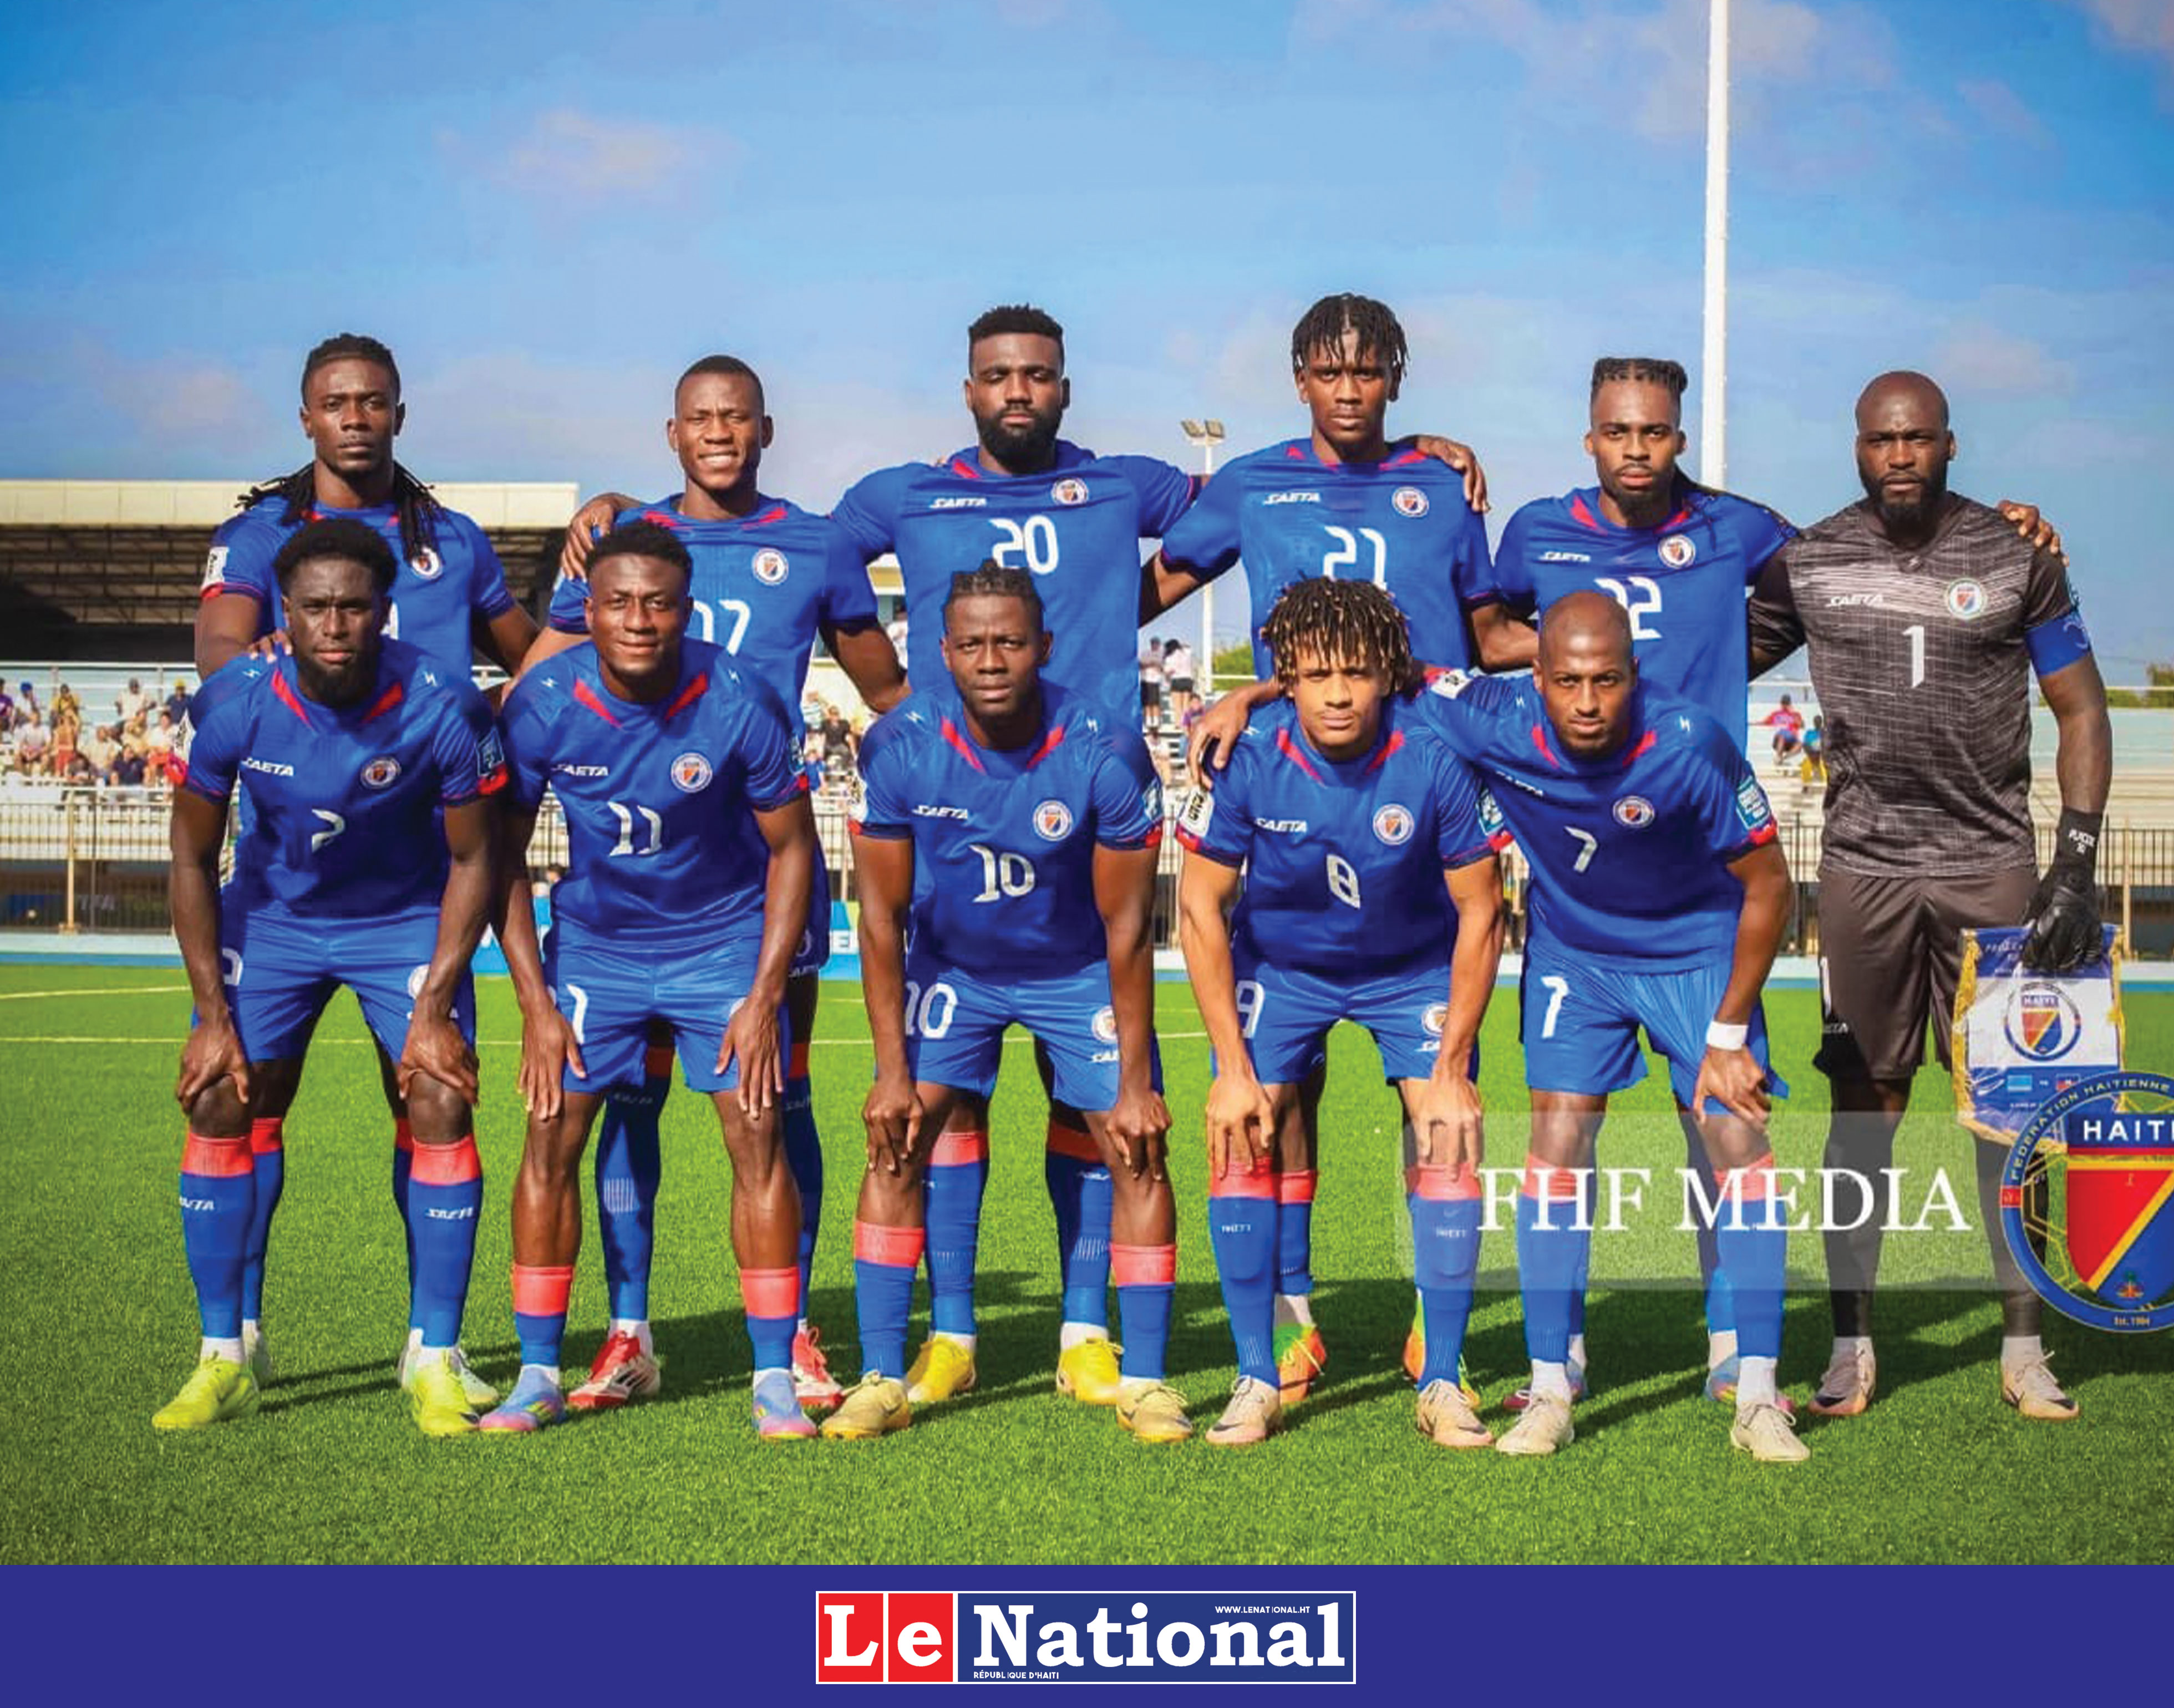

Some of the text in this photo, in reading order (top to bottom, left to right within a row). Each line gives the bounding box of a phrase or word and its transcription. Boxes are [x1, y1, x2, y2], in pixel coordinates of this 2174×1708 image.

[988, 515, 1059, 575] 20
[1903, 625, 1925, 689] 1
[607, 801, 662, 857] 11
[1565, 826, 1597, 872] 7
[969, 844, 1035, 902] 10
[905, 980, 958, 1039] 10
[1541, 975, 1569, 1039] 7
